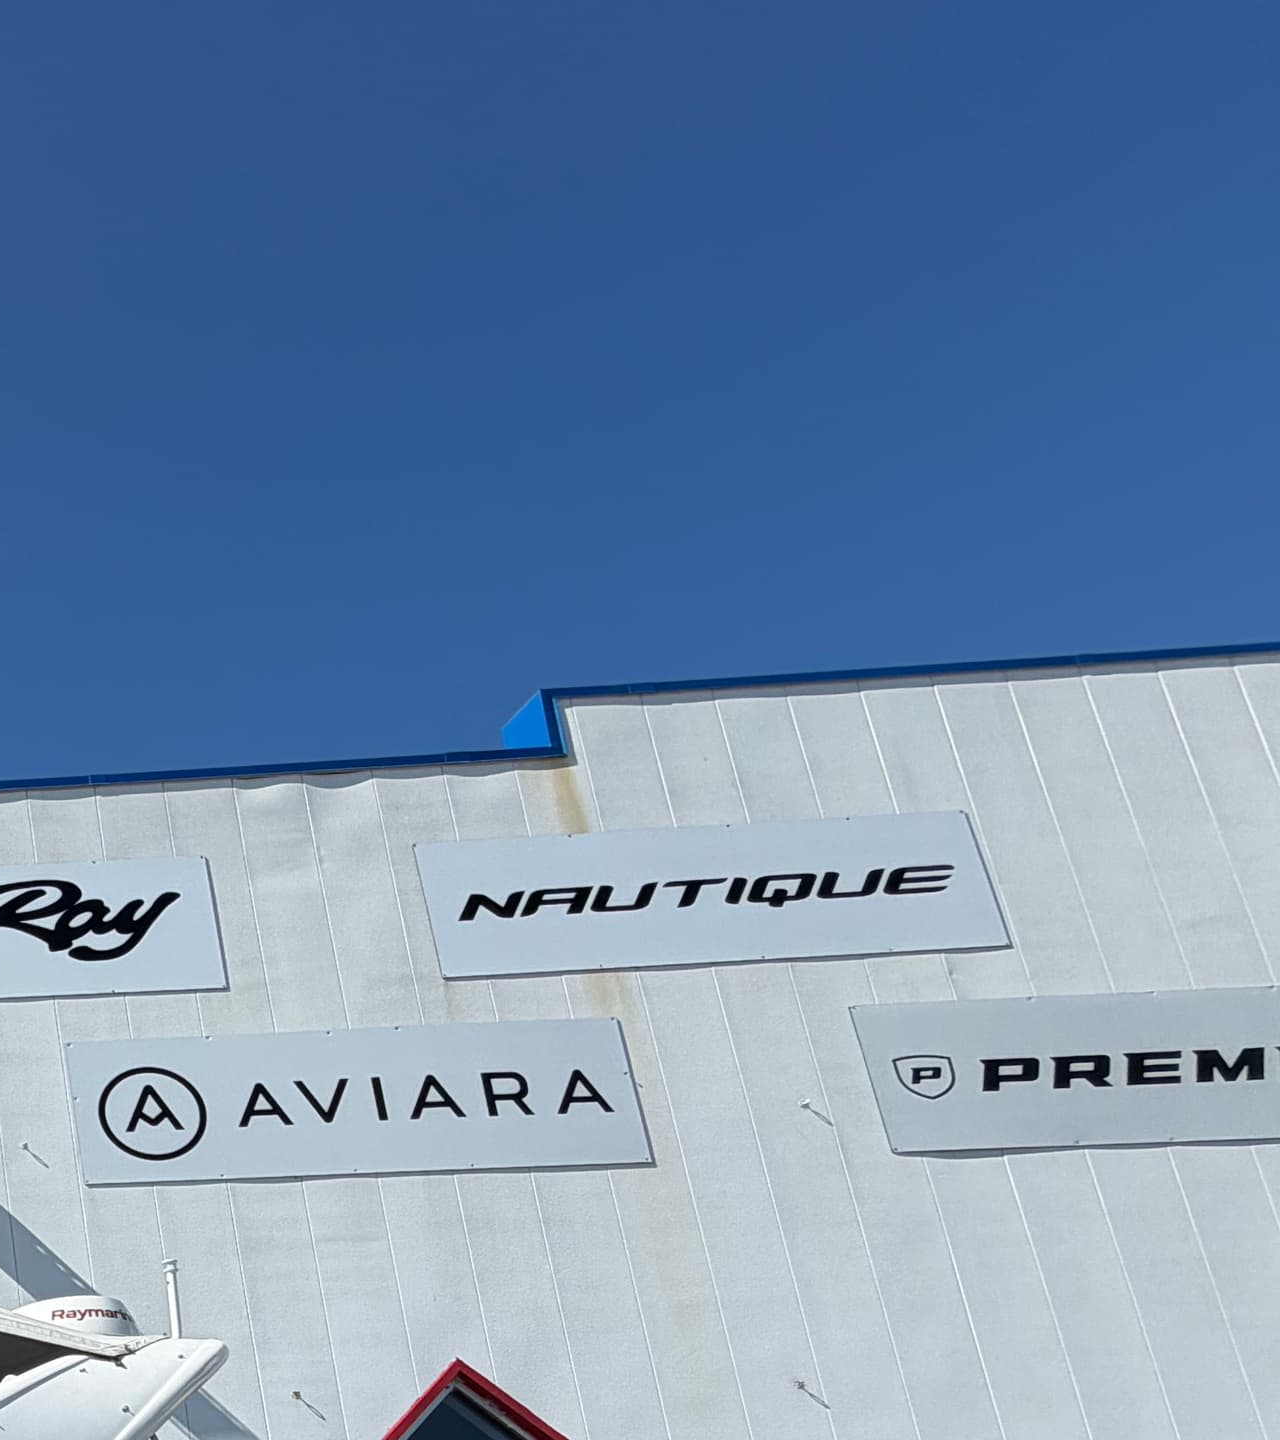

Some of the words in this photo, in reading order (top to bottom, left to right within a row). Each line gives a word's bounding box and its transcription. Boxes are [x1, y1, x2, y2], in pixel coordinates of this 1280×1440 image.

[458, 864, 955, 922] NAUTIQUE
[238, 1068, 615, 1128] AVIARA
[979, 1046, 1280, 1092] PREM
